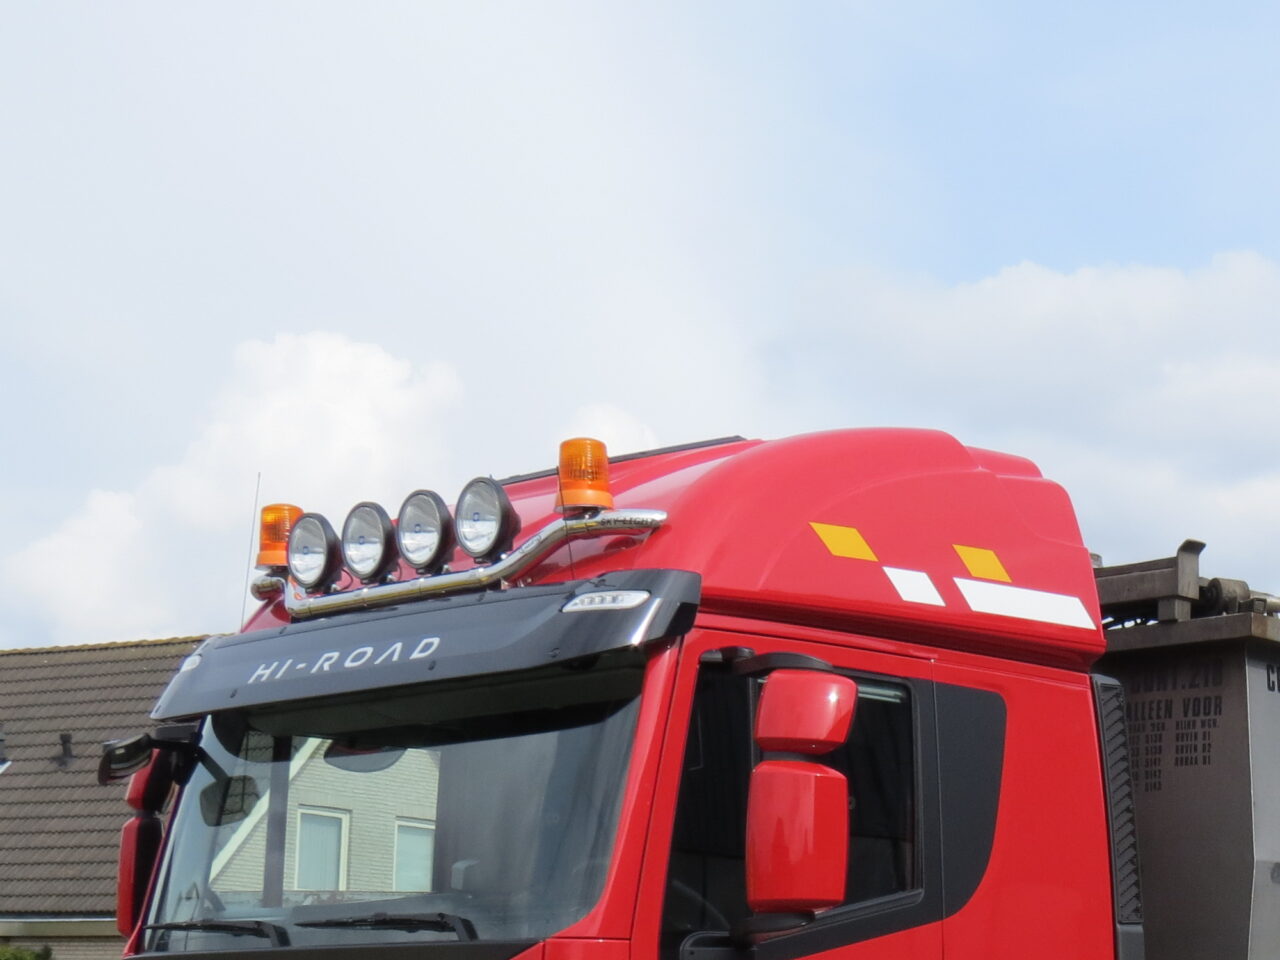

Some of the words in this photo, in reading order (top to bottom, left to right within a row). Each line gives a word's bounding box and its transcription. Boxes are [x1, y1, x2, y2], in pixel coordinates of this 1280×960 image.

[248, 637, 441, 684] HI-ROAD
[1126, 699, 1173, 721] ALLEEN
[1182, 696, 1222, 718] VOOR
